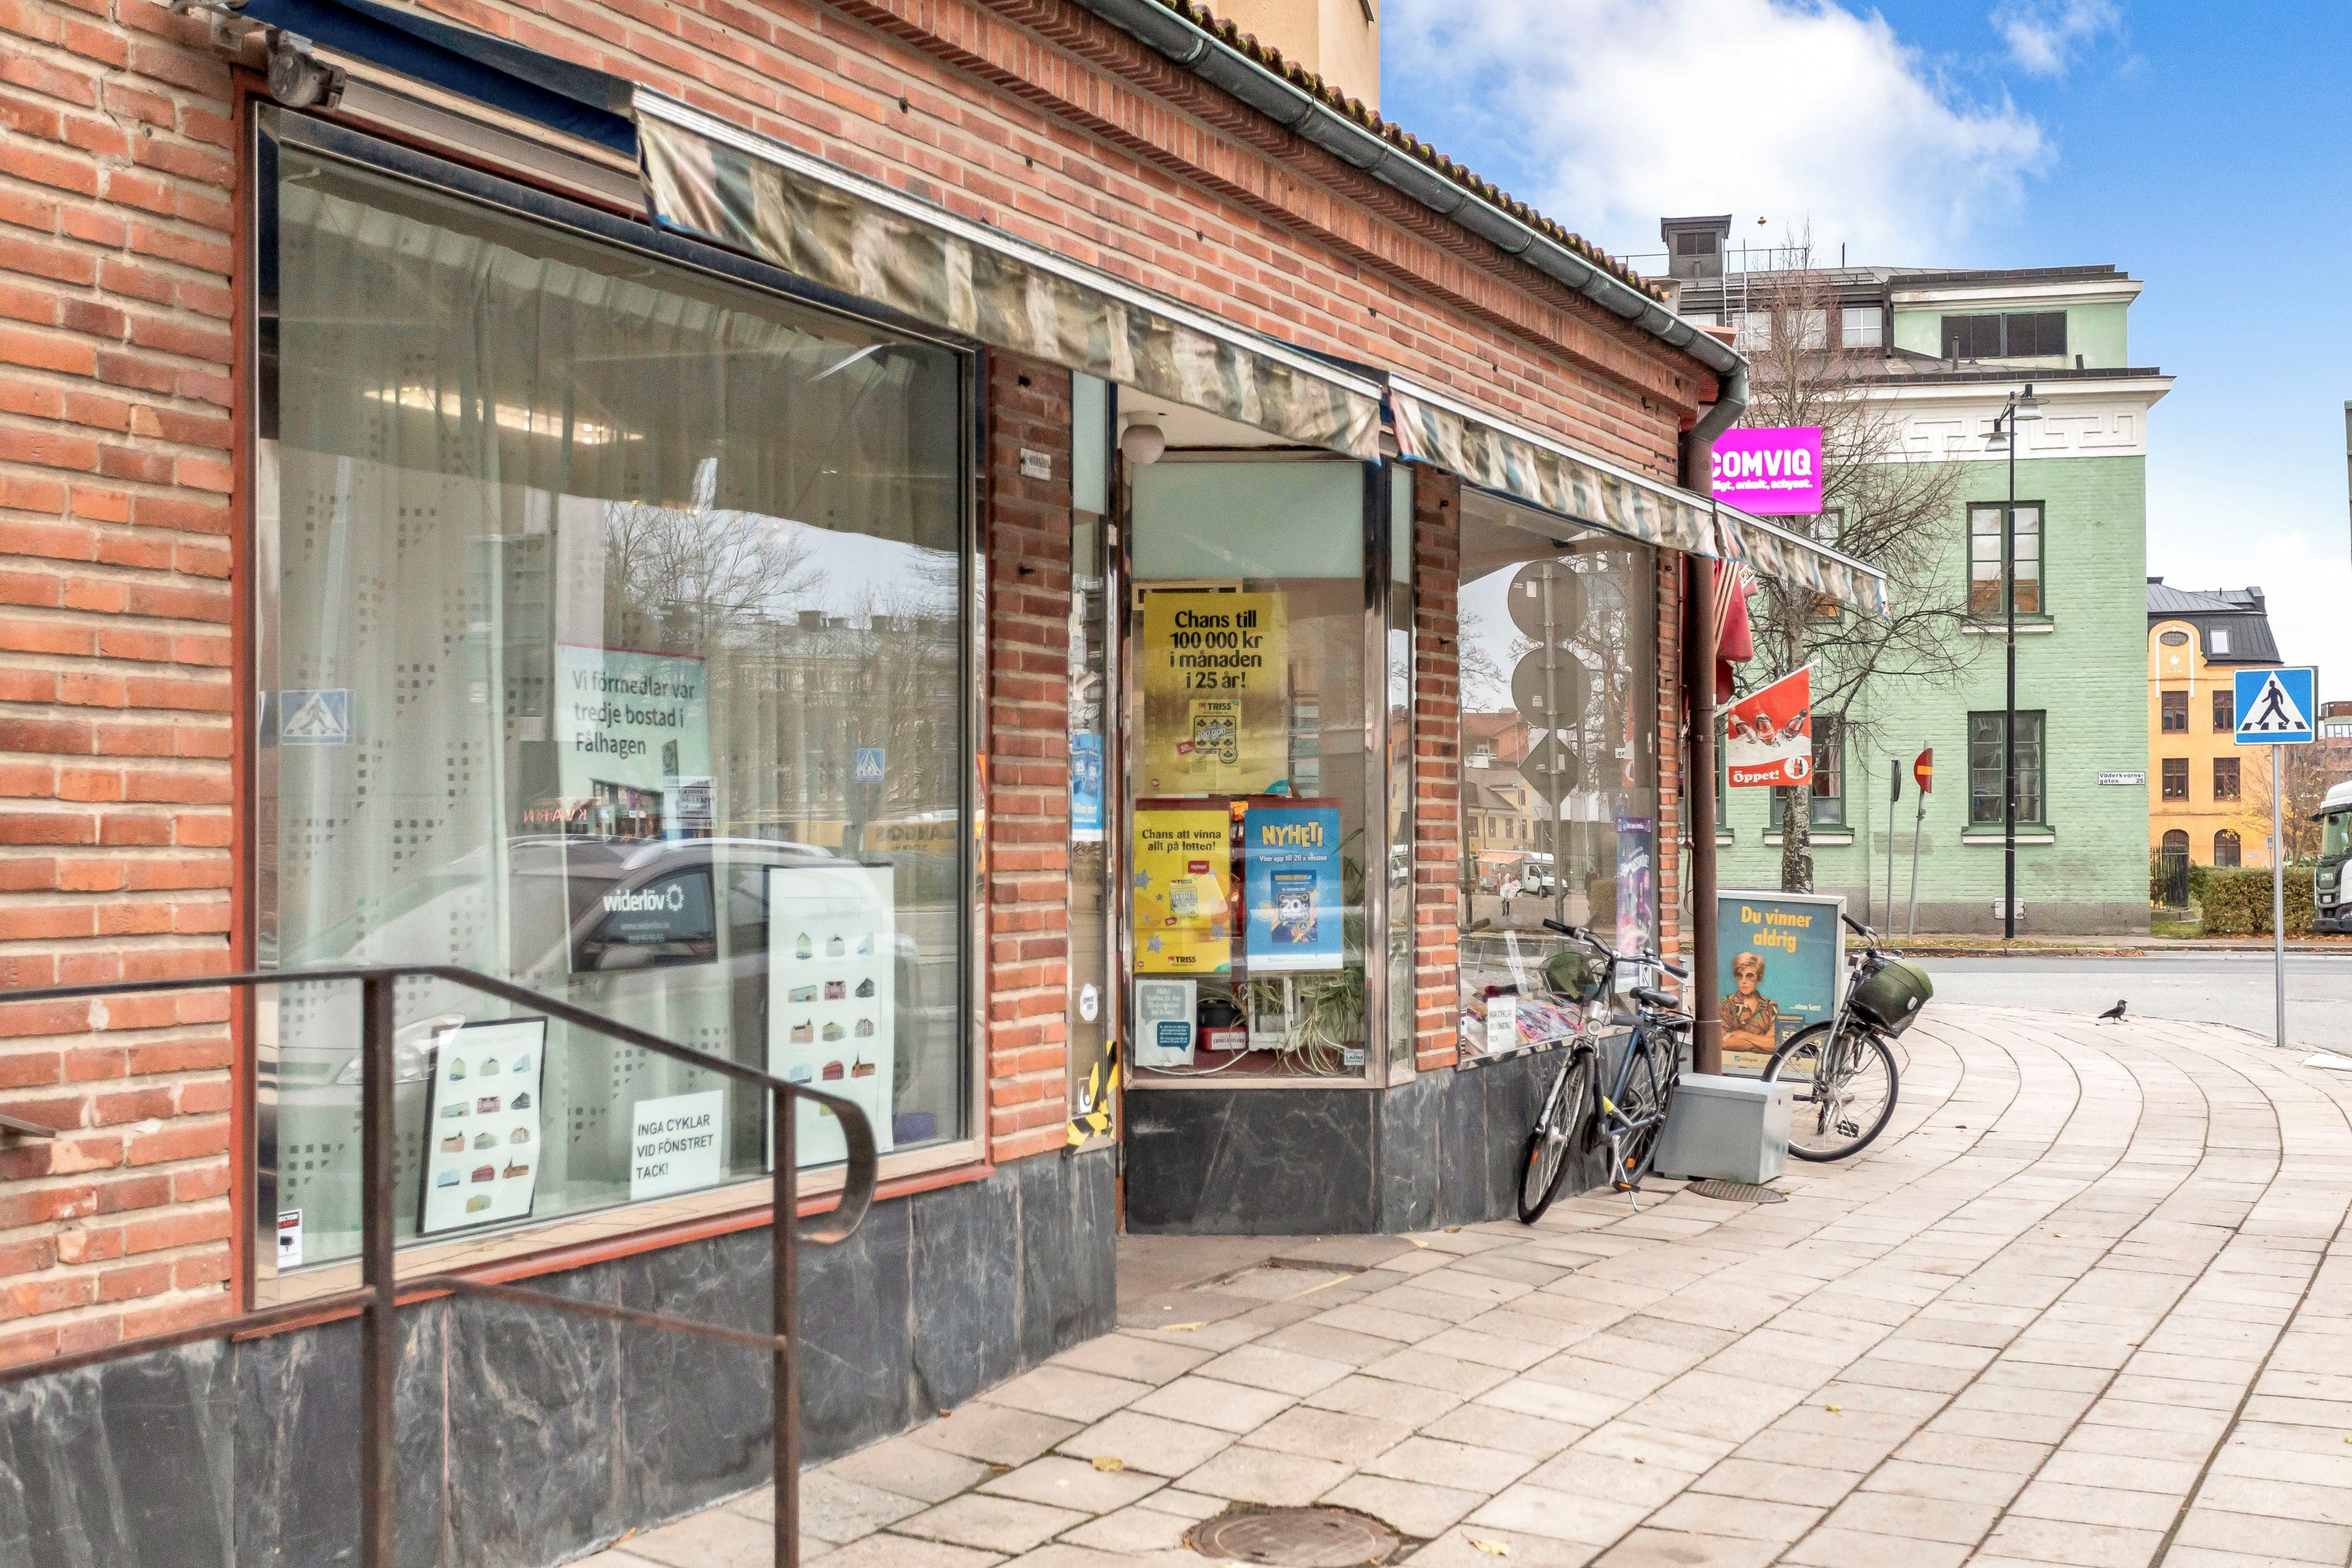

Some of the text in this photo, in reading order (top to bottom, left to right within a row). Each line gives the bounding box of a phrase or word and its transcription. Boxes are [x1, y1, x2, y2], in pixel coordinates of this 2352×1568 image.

[1712, 449, 1813, 478] COMVIQ
[1174, 611, 1257, 629] Chans till
[1169, 631, 1263, 650] 100 000 kr
[1169, 648, 1262, 669] i månaden
[573, 669, 695, 700] Vi förmedlar var
[1186, 670, 1246, 690] i 25 år!
[574, 701, 685, 728] tredje bostad i
[576, 730, 646, 760] Fålhagen
[1733, 770, 1780, 784] Öppet!
[1142, 830, 1222, 840] Chans att vinna
[1262, 822, 1324, 848] NYHET!
[1148, 841, 1216, 854] allt på lotten!
[603, 889, 665, 911] widerlöv
[1741, 906, 1813, 928] Du vinner
[1753, 928, 1797, 953] aldrig
[638, 1114, 711, 1137] INGA CYKLAR
[637, 1135, 714, 1158] VID FÖNSTRET
[636, 1163, 669, 1180] TACK!
